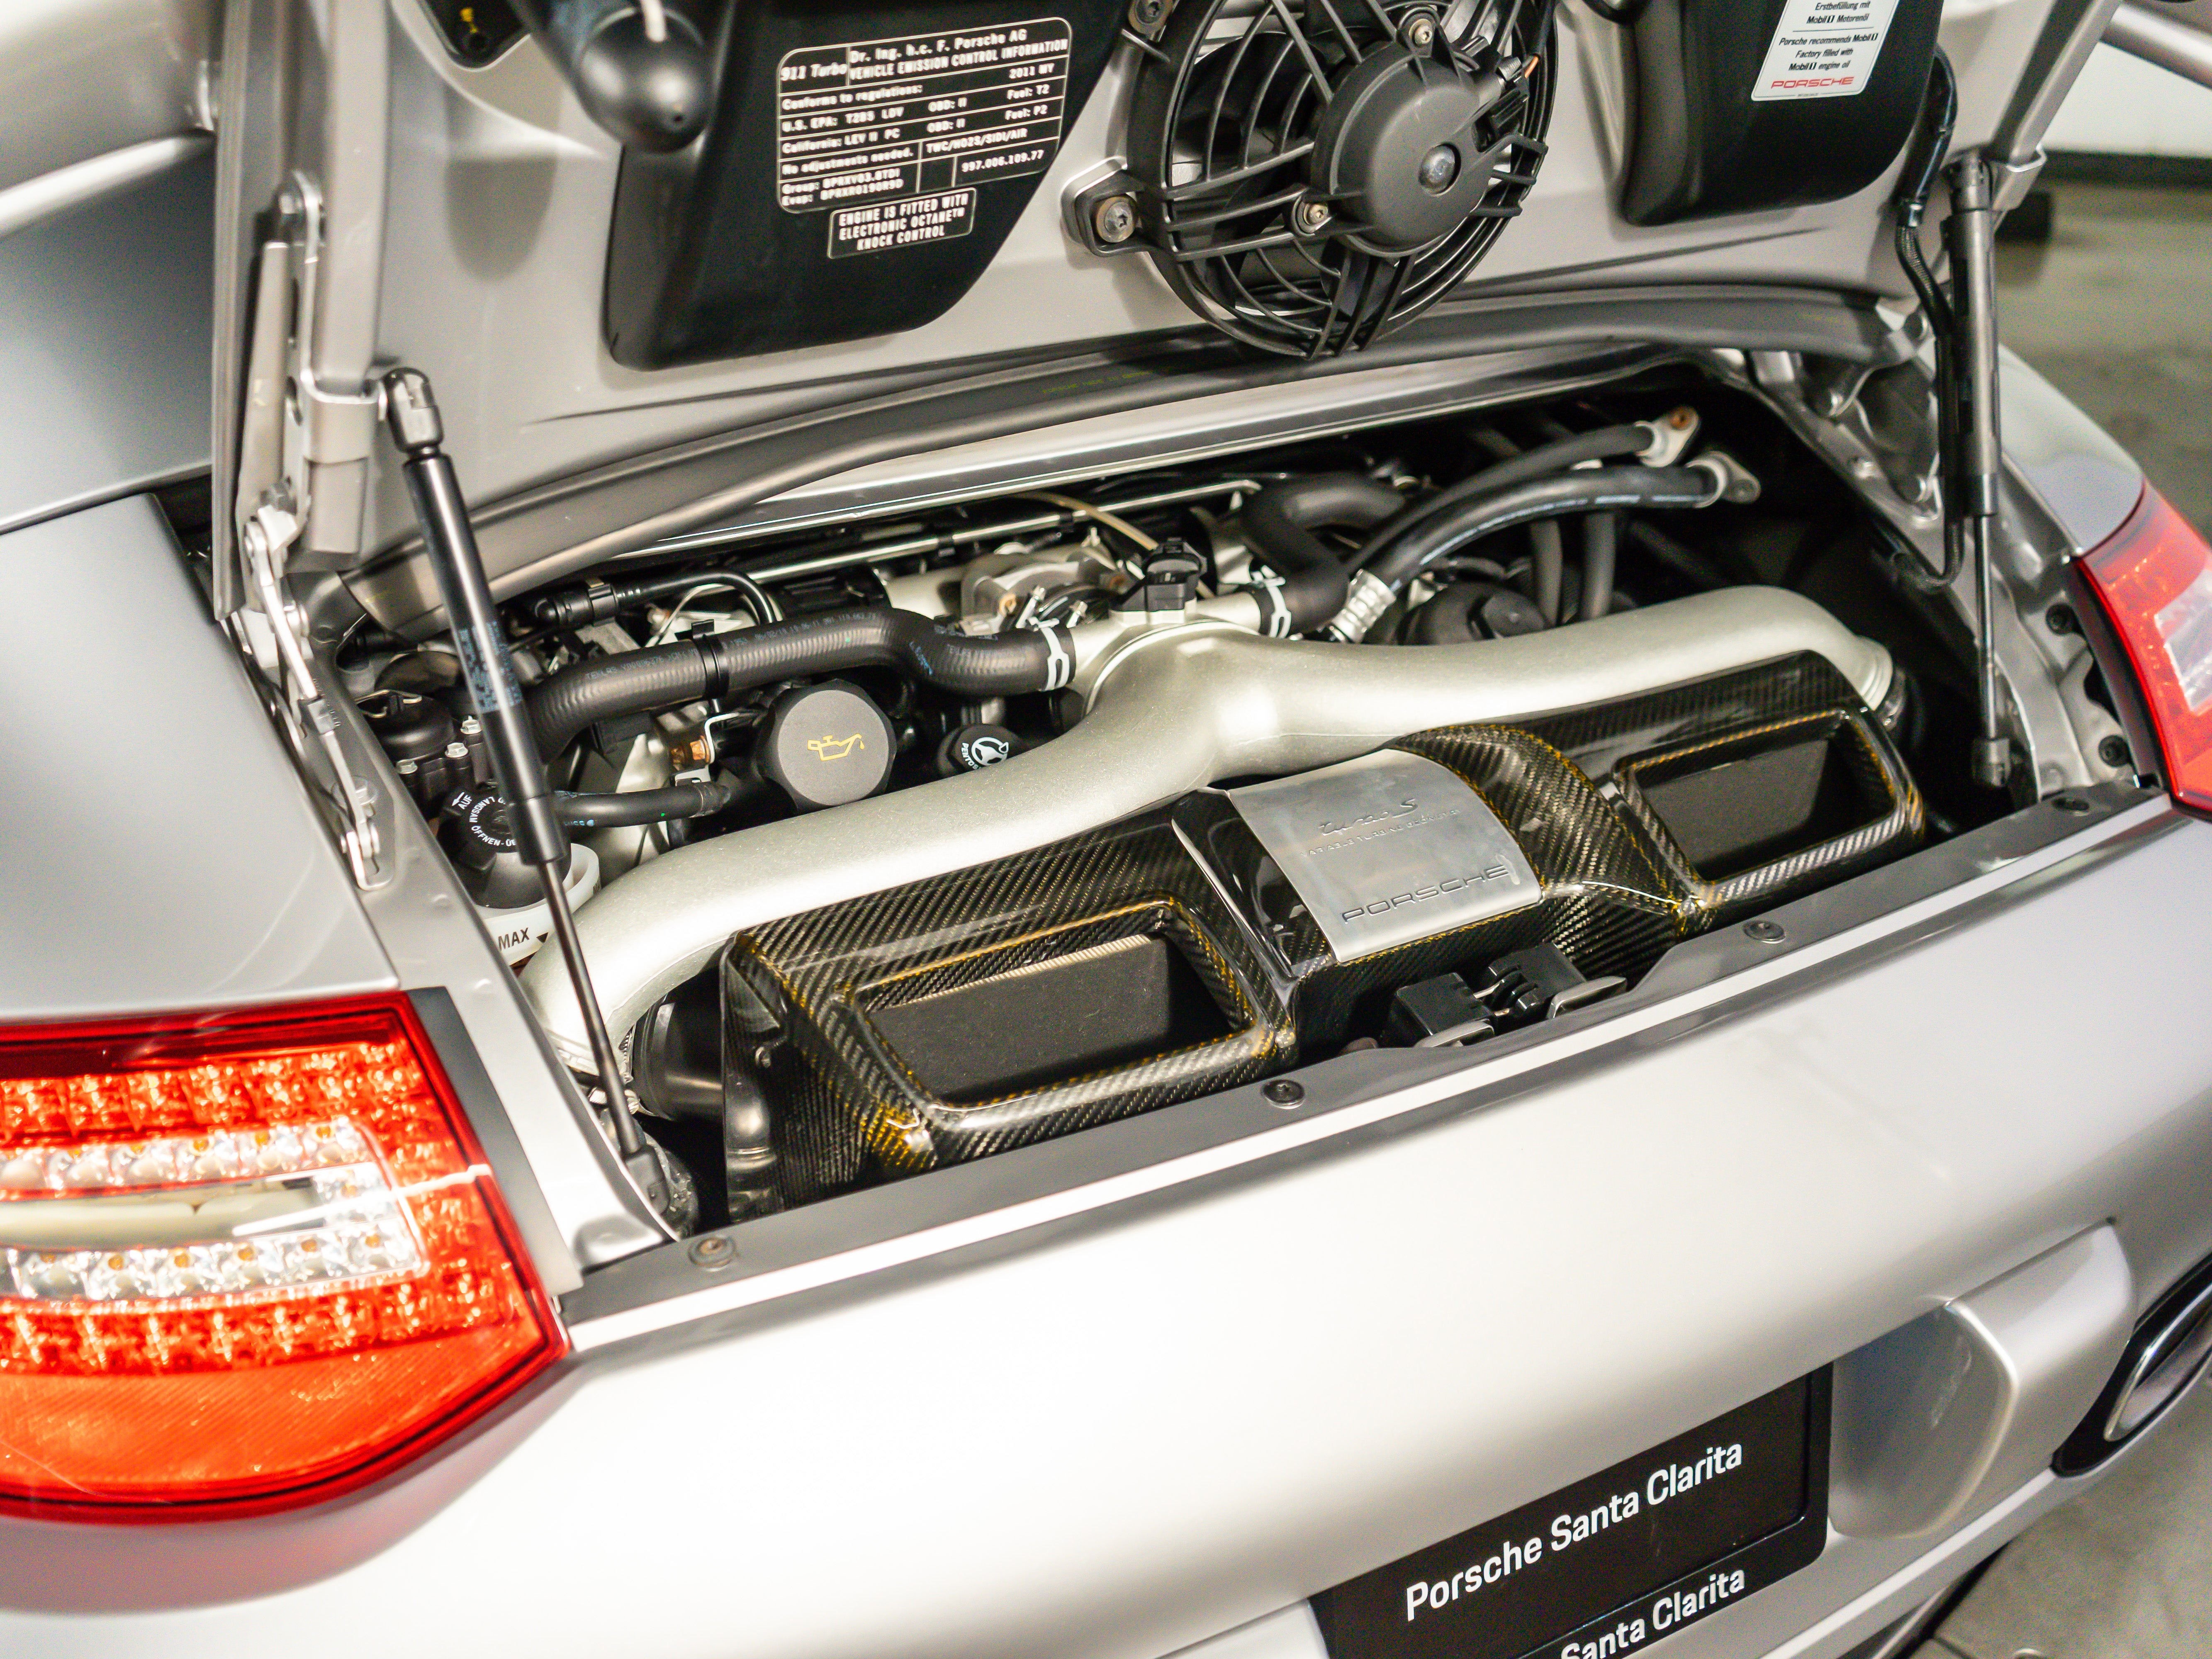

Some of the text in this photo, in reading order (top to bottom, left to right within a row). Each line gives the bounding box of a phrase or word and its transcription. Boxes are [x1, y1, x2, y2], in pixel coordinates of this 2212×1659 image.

[850, 29, 1027, 63] Dr. Ing. h.c. F. Porsche AG
[1779, 37, 1808, 45] Porsche
[1808, 35, 1852, 45] recommends
[850, 39, 1068, 80] VEHICLE EMISSION CONTROL INFORMATION
[1795, 50, 1822, 59] Factory
[1823, 48, 1840, 57] filled
[1818, 61, 1840, 71] engine
[1842, 60, 1851, 68] oil
[781, 63, 848, 81] 911 Turbo
[1009, 63, 1055, 79] 2011 MY
[1771, 77, 1854, 89] PORSCHE
[782, 85, 923, 110] Conforms to regulations:
[782, 119, 808, 132] U.S.
[810, 116, 838, 129] EPA:
[928, 100, 956, 112] OBD:
[1007, 88, 1033, 100] Fuel:
[1036, 84, 1050, 95] T2
[782, 138, 842, 153] California:
[844, 133, 867, 145] LEV
[884, 128, 900, 140] PC
[927, 121, 954, 133] OBD:
[1005, 108, 1031, 120] Fuel:
[1033, 105, 1048, 116] P2
[782, 147, 914, 175] No adjustments needed.
[961, 149, 1044, 172] 997.006.109.77
[781, 194, 813, 207] Evap:
[782, 182, 820, 195] Group:
[839, 193, 969, 226] ENGINE IS FITTED WITH
[839, 217, 907, 241] ELECTRONIC
[857, 224, 945, 251] KNOCK CONTROL
[458, 795, 472, 810] AUF
[469, 796, 495, 823] LANGSAM
[1341, 865, 1510, 924] PORSCHE
[498, 927, 530, 951] MAX
[1406, 1443, 1742, 1622] Porsche Santa Clarita
[1652, 1569, 1745, 1630] Clarita
